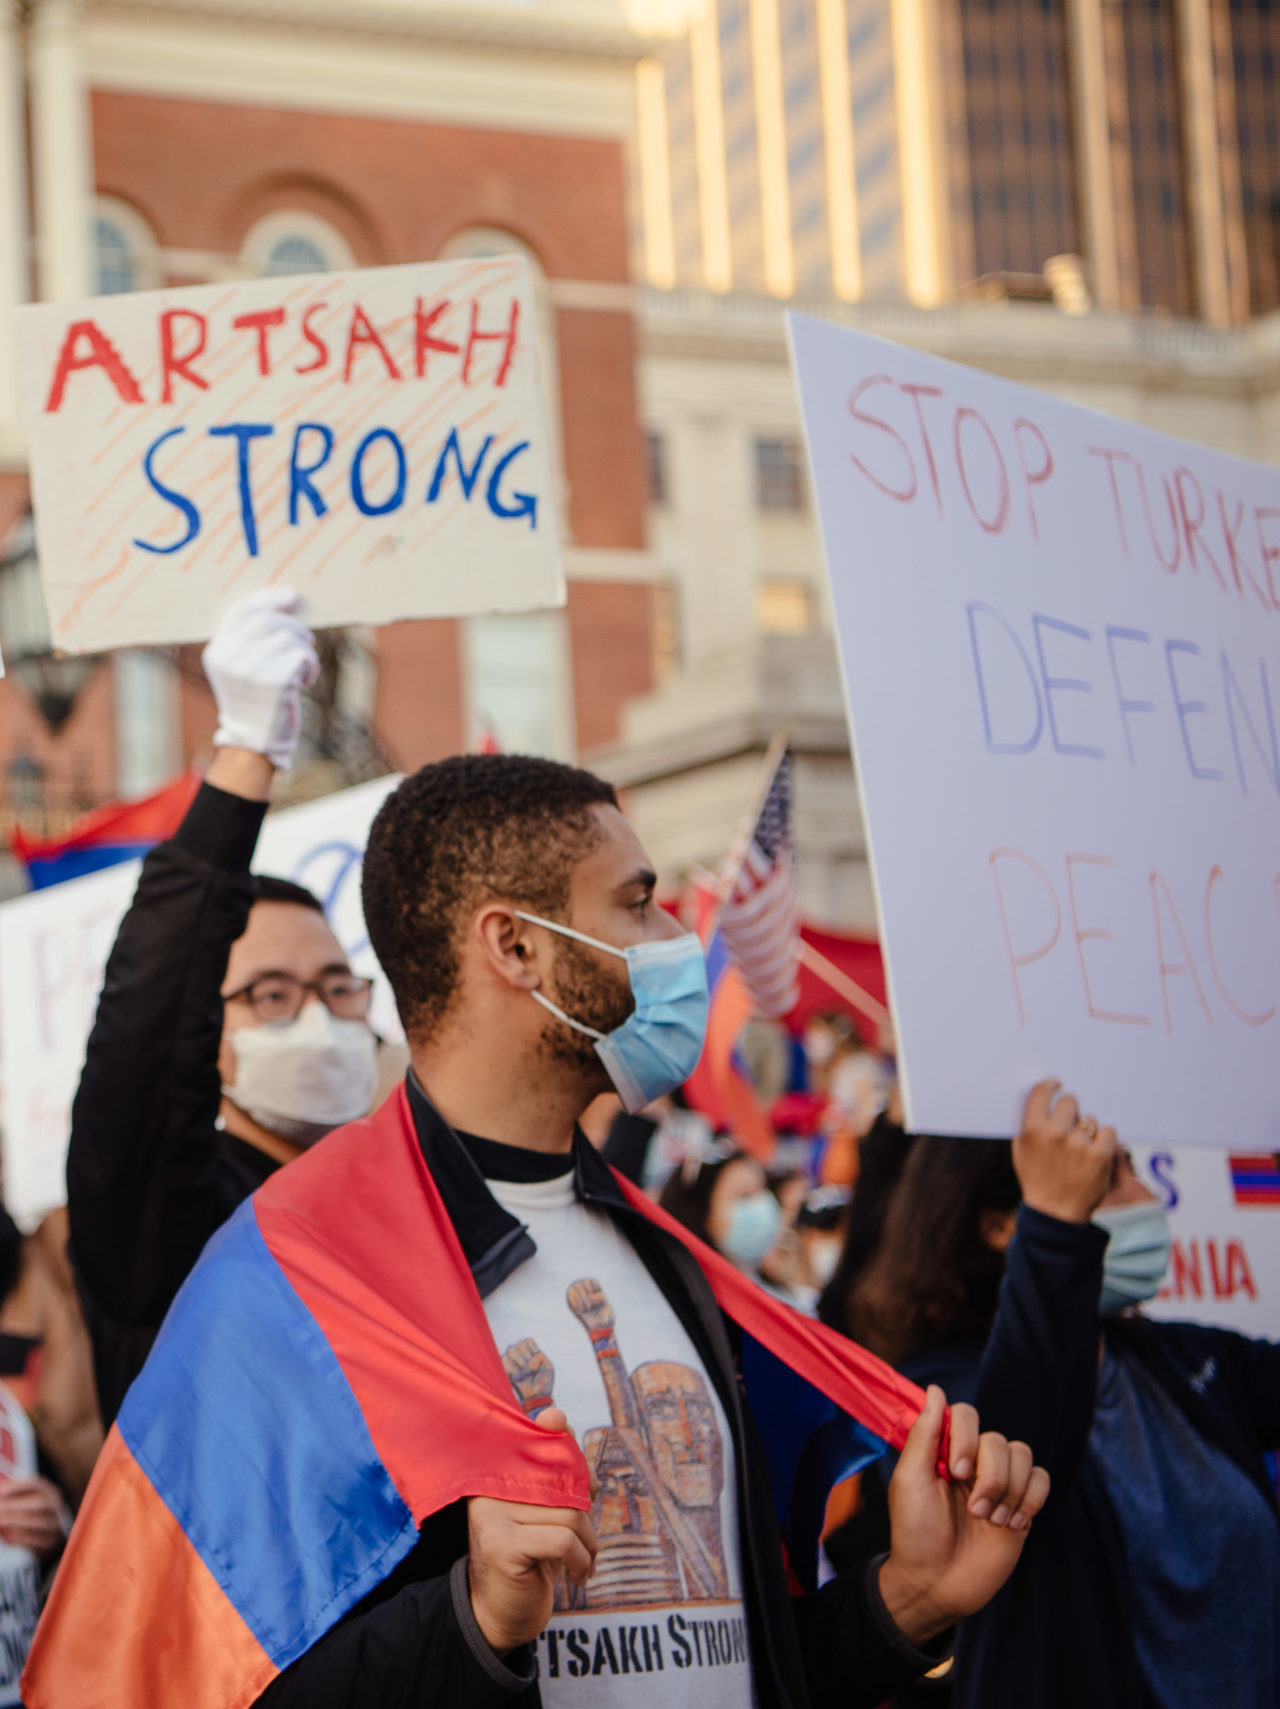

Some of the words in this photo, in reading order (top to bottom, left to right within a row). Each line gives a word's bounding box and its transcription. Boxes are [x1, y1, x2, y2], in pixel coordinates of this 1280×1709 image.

[43, 296, 521, 413] ARTSAKH
[132, 422, 539, 558] STRONG
[846, 373, 1055, 543] STOP
[966, 600, 1280, 799] DEFEN
[988, 846, 1280, 1037] PEAC
[1157, 1236, 1258, 1303] NIA
[532, 1624, 664, 1678] TSAKH
